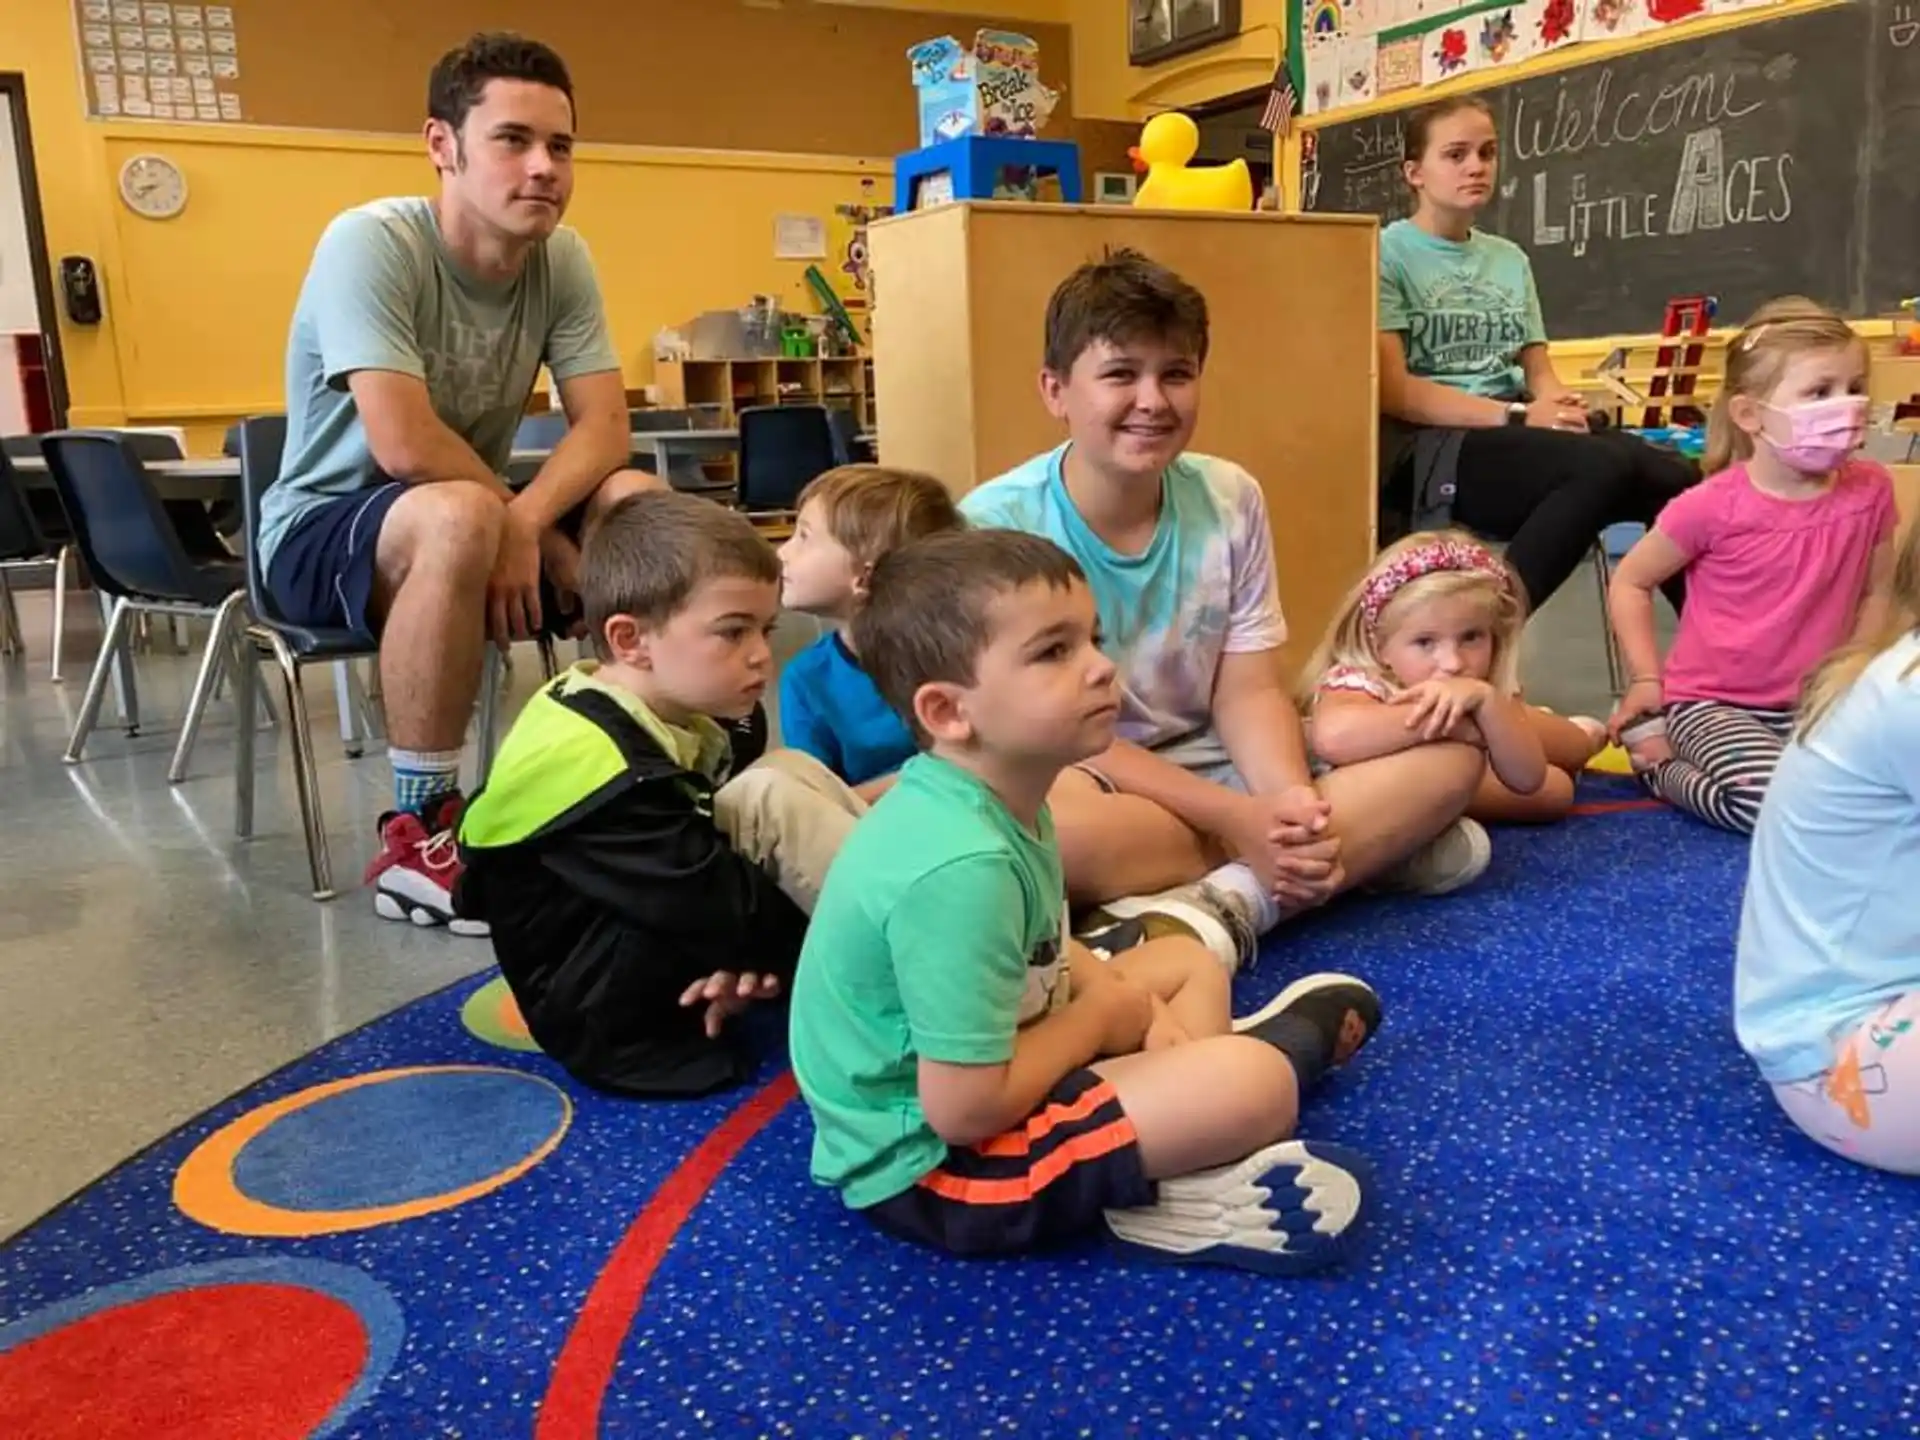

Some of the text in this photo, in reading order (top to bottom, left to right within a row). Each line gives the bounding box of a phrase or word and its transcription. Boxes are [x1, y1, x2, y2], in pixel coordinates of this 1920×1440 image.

[977, 67, 1030, 108] Break
[1514, 68, 1763, 160] Welcome
[1667, 127, 1794, 236] ACES
